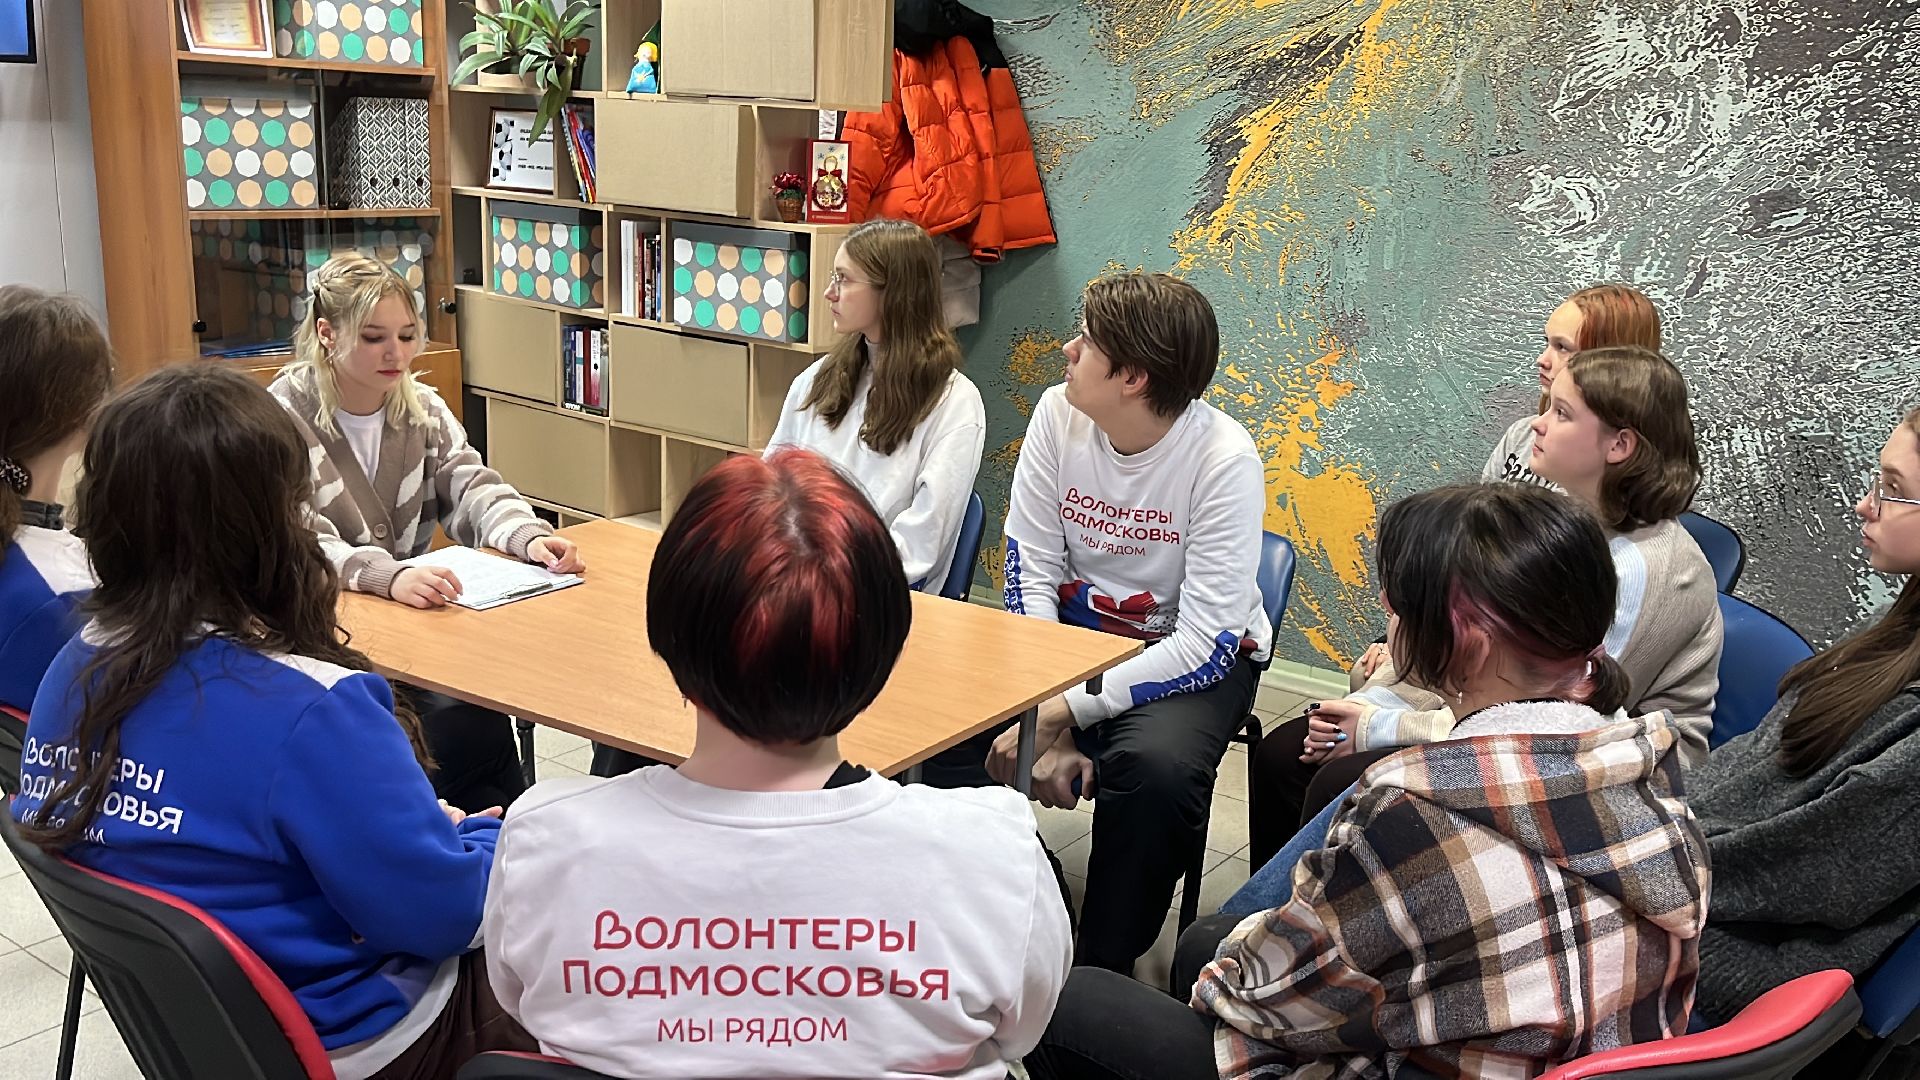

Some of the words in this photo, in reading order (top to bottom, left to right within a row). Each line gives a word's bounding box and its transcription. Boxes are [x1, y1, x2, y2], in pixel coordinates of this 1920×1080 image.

[1059, 501, 1180, 544] ОДМОСКОВЬЯ
[593, 909, 917, 952] ВОЛОНТЕРЫ
[562, 959, 949, 1001] ПОДМОСКОВЬЯ
[657, 1016, 714, 1043] МЫ
[726, 1016, 848, 1048] РЯДОМ
